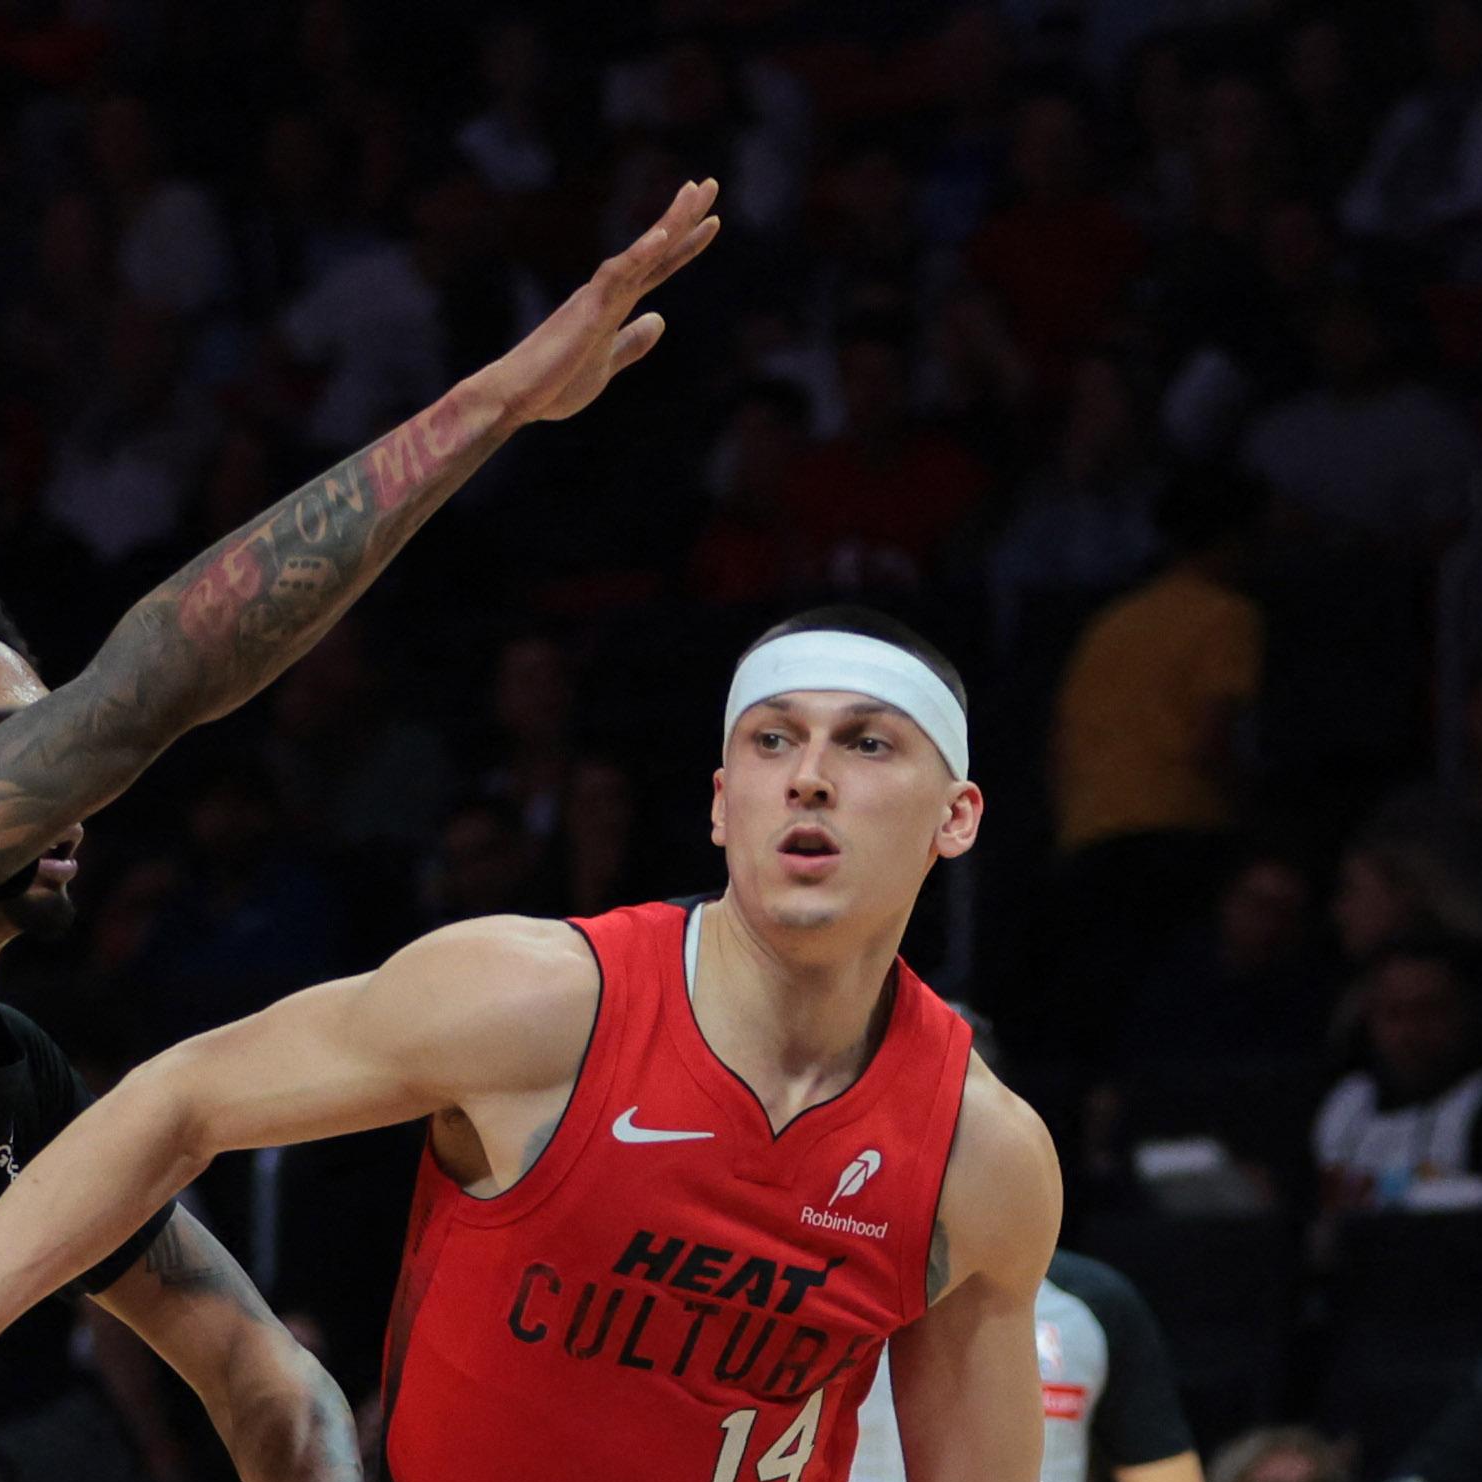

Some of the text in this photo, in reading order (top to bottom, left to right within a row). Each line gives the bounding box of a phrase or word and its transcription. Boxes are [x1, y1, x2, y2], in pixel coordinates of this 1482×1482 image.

[800, 1206, 888, 1239] Robinhood
[613, 1230, 847, 1315] HEAT
[508, 1262, 878, 1396] CULTURE
